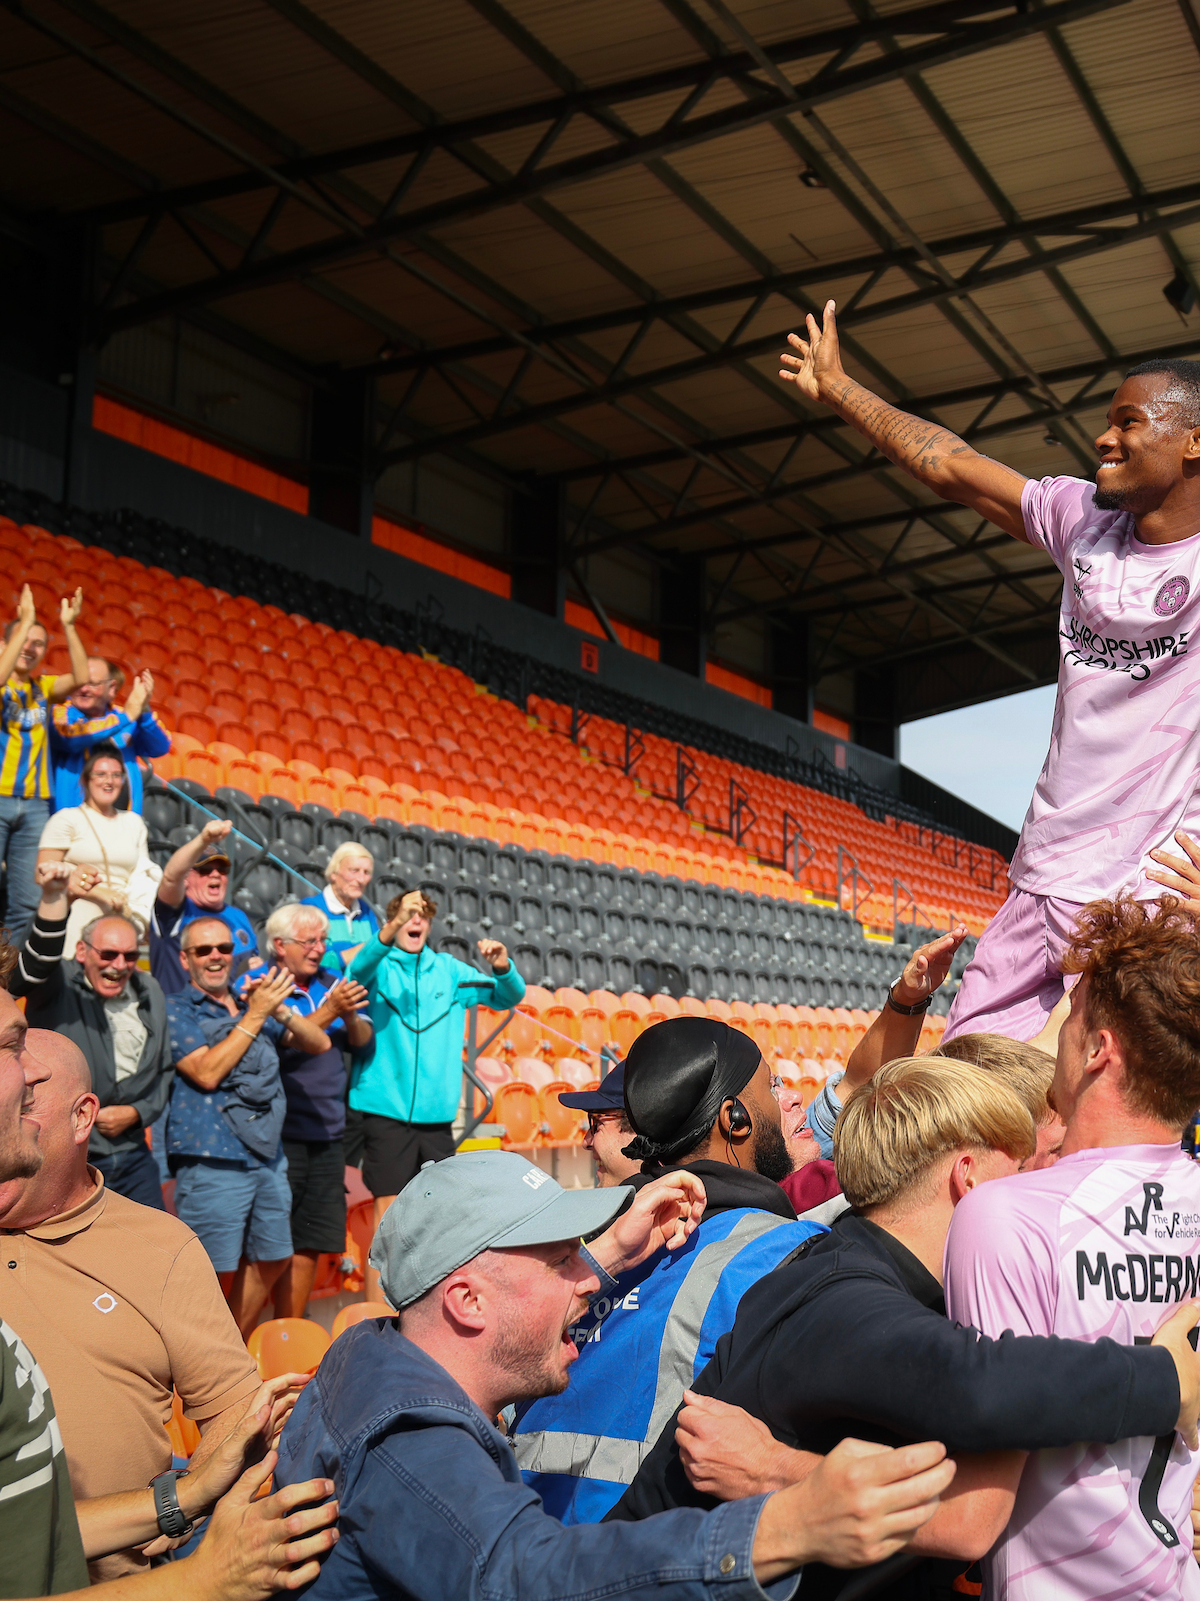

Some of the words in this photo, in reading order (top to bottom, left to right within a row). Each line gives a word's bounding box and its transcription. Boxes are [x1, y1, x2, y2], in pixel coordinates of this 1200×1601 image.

[1060, 617, 1190, 660] SHROPSHIRE
[1152, 1214, 1168, 1224] The
[1154, 1227, 1166, 1238] for
